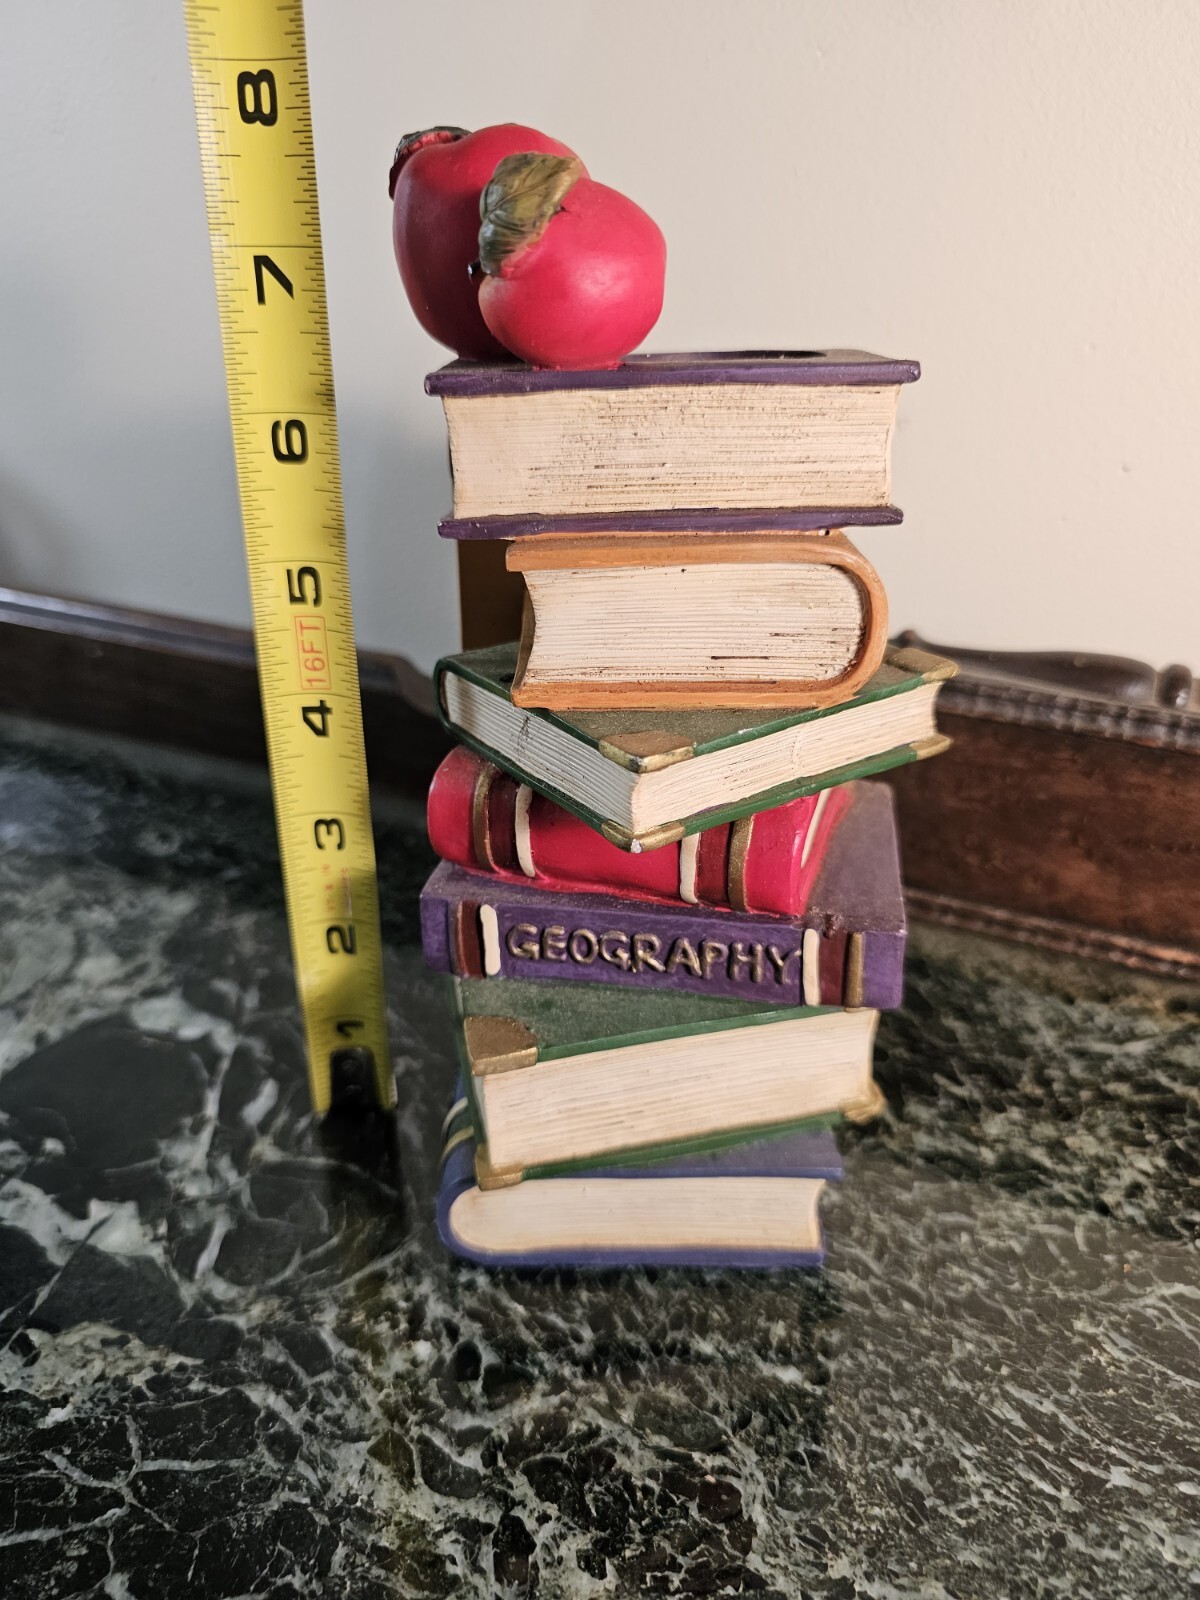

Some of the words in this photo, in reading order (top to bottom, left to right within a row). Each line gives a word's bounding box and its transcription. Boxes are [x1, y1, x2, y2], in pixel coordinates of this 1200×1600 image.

[237, 69, 277, 126] 8
[253, 255, 294, 305] 7
[271, 419, 308, 465] 6
[286, 566, 322, 607] 5
[299, 620, 328, 688] 16FT
[301, 699, 332, 737] 4
[314, 818, 345, 850] 3
[326, 924, 357, 955] 2
[506, 923, 801, 984] GEOGRAPHY
[336, 1019, 364, 1037] 1
